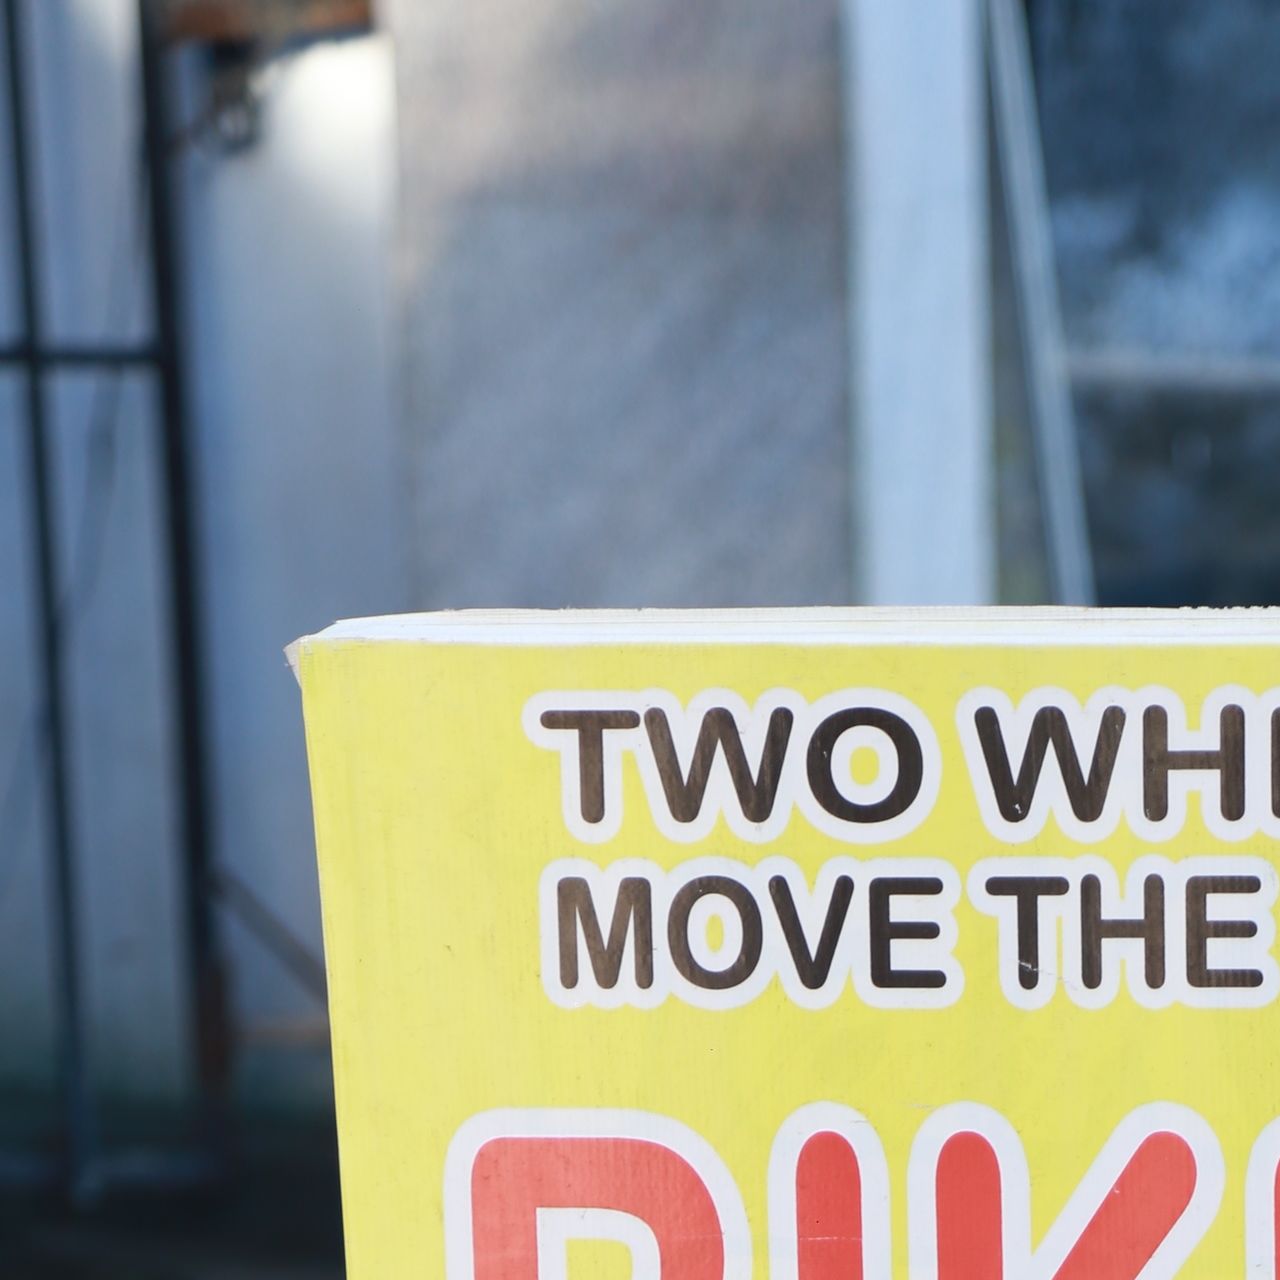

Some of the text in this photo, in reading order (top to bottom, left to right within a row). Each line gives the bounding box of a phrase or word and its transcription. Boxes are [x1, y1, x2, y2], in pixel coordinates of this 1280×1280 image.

[540, 706, 924, 824] TWO
[556, 875, 947, 990] MOVE
[985, 874, 1265, 991] THE
